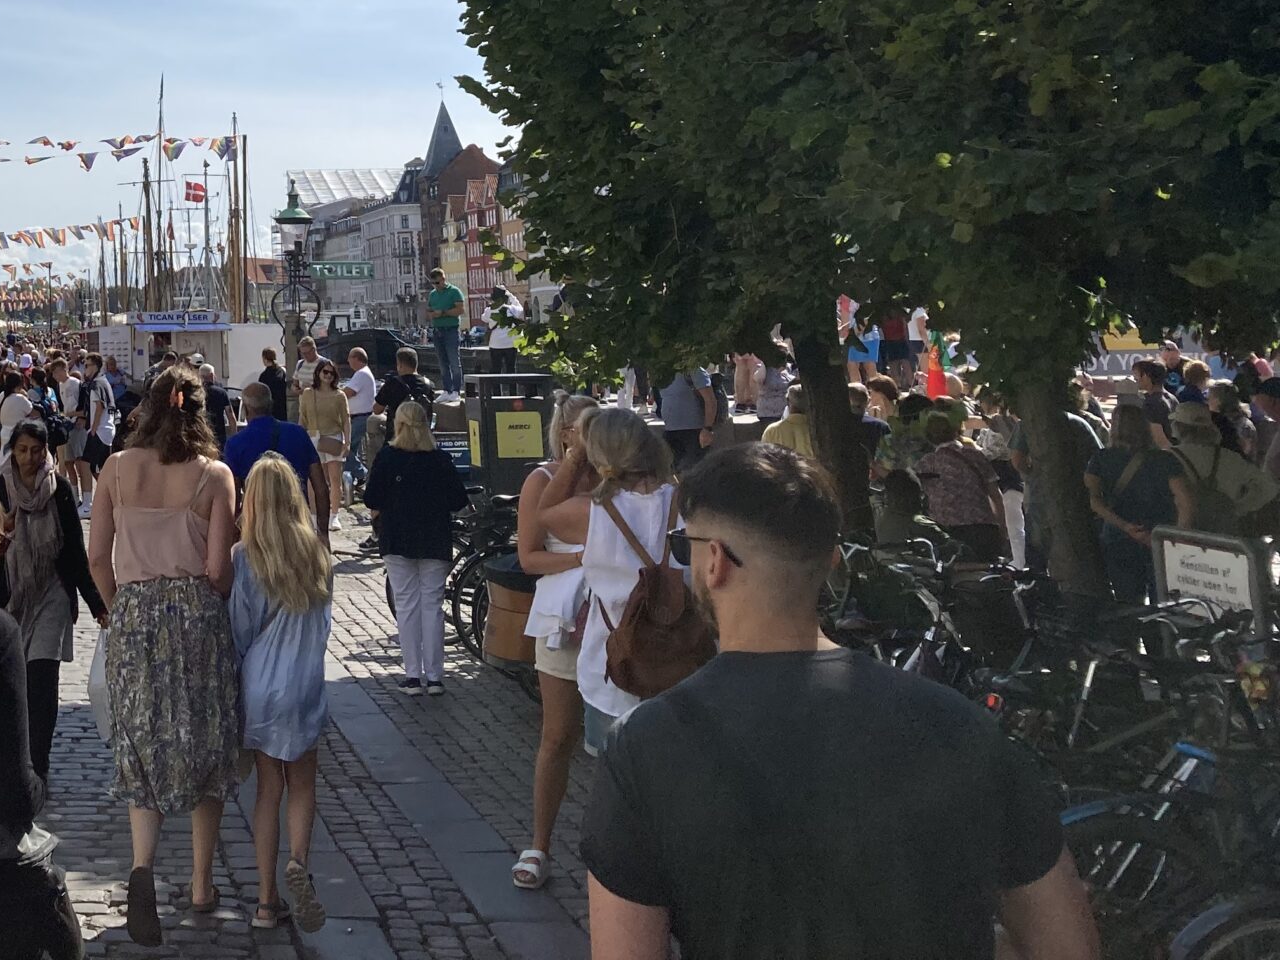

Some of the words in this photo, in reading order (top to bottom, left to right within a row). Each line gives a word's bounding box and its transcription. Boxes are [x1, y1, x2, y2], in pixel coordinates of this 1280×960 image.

[312, 264, 372, 277] TOILET
[148, 313, 174, 321] TICAN
[176, 313, 208, 321] PLSER
